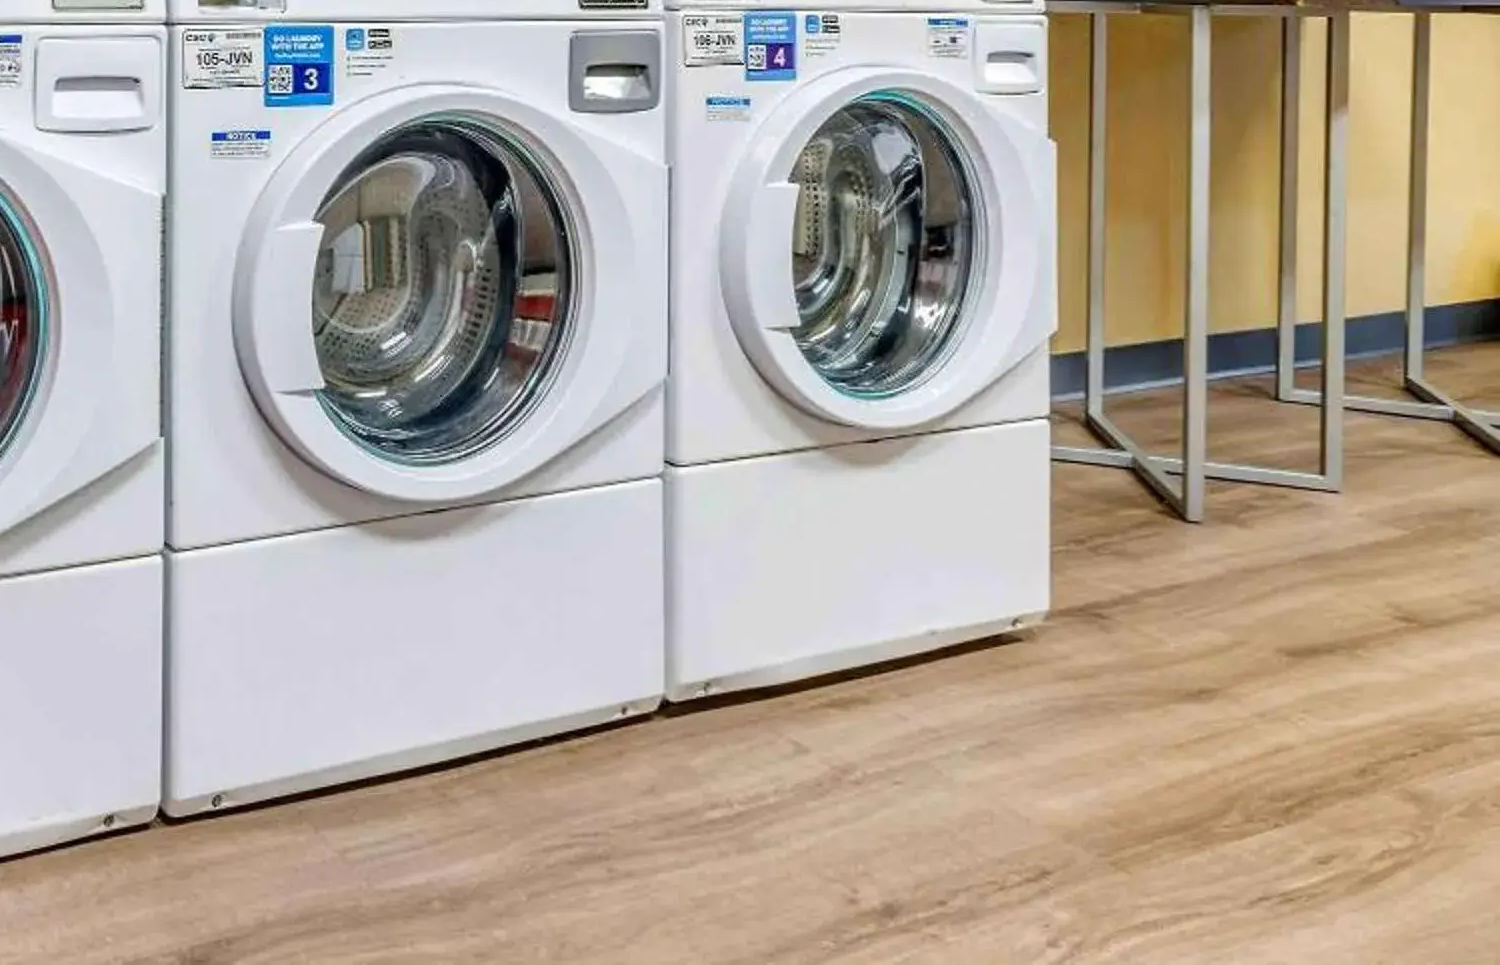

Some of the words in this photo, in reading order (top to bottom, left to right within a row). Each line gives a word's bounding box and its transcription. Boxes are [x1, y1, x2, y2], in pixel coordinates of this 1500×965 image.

[195, 51, 253, 67] 105-JVN
[773, 46, 787, 68] 4
[303, 68, 319, 90] 3
